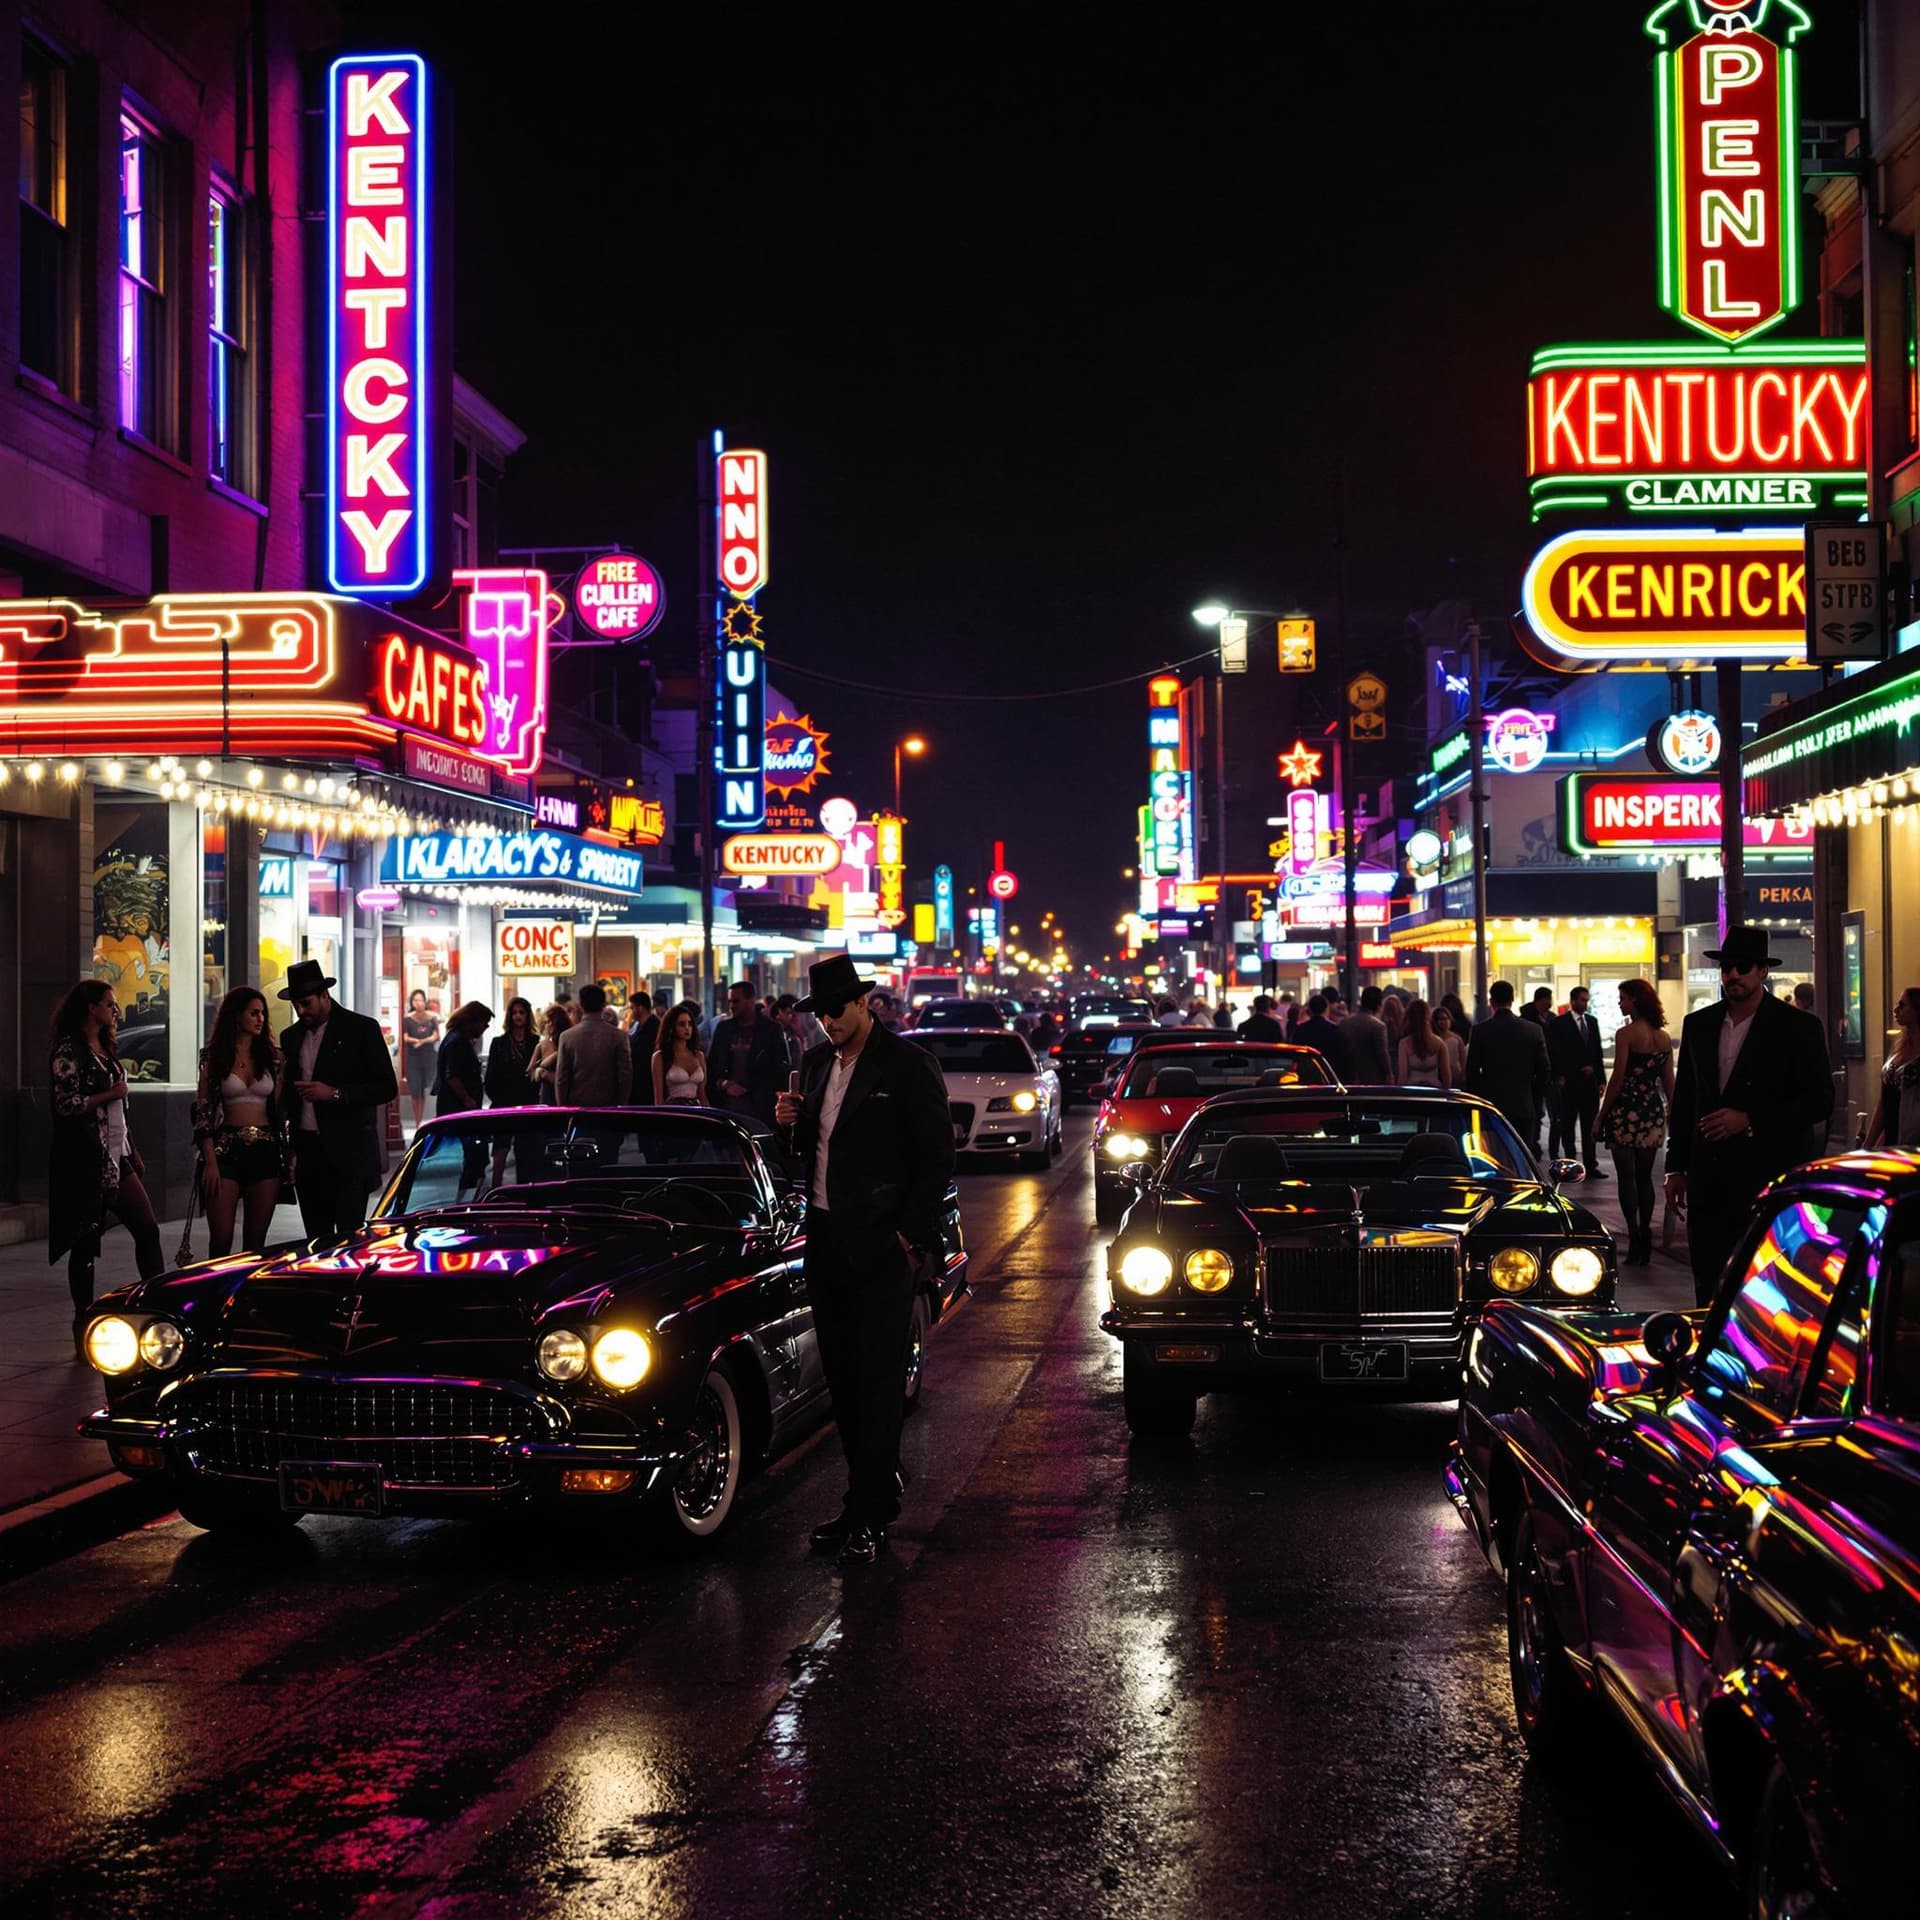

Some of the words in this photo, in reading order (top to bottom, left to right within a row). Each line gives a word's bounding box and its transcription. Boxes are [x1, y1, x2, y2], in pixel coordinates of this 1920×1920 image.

[1700, 44, 1765, 318] PENL
[340, 71, 412, 574] KENTCKY
[1546, 373, 1867, 465] KENTUCKY
[1625, 479, 1813, 504] CLAMNER
[597, 560, 638, 583] FREE
[1567, 561, 1806, 619] KENRICK
[596, 606, 639, 629] CAFE
[384, 635, 486, 744] CAFES
[732, 846, 825, 864] KENTUCKY
